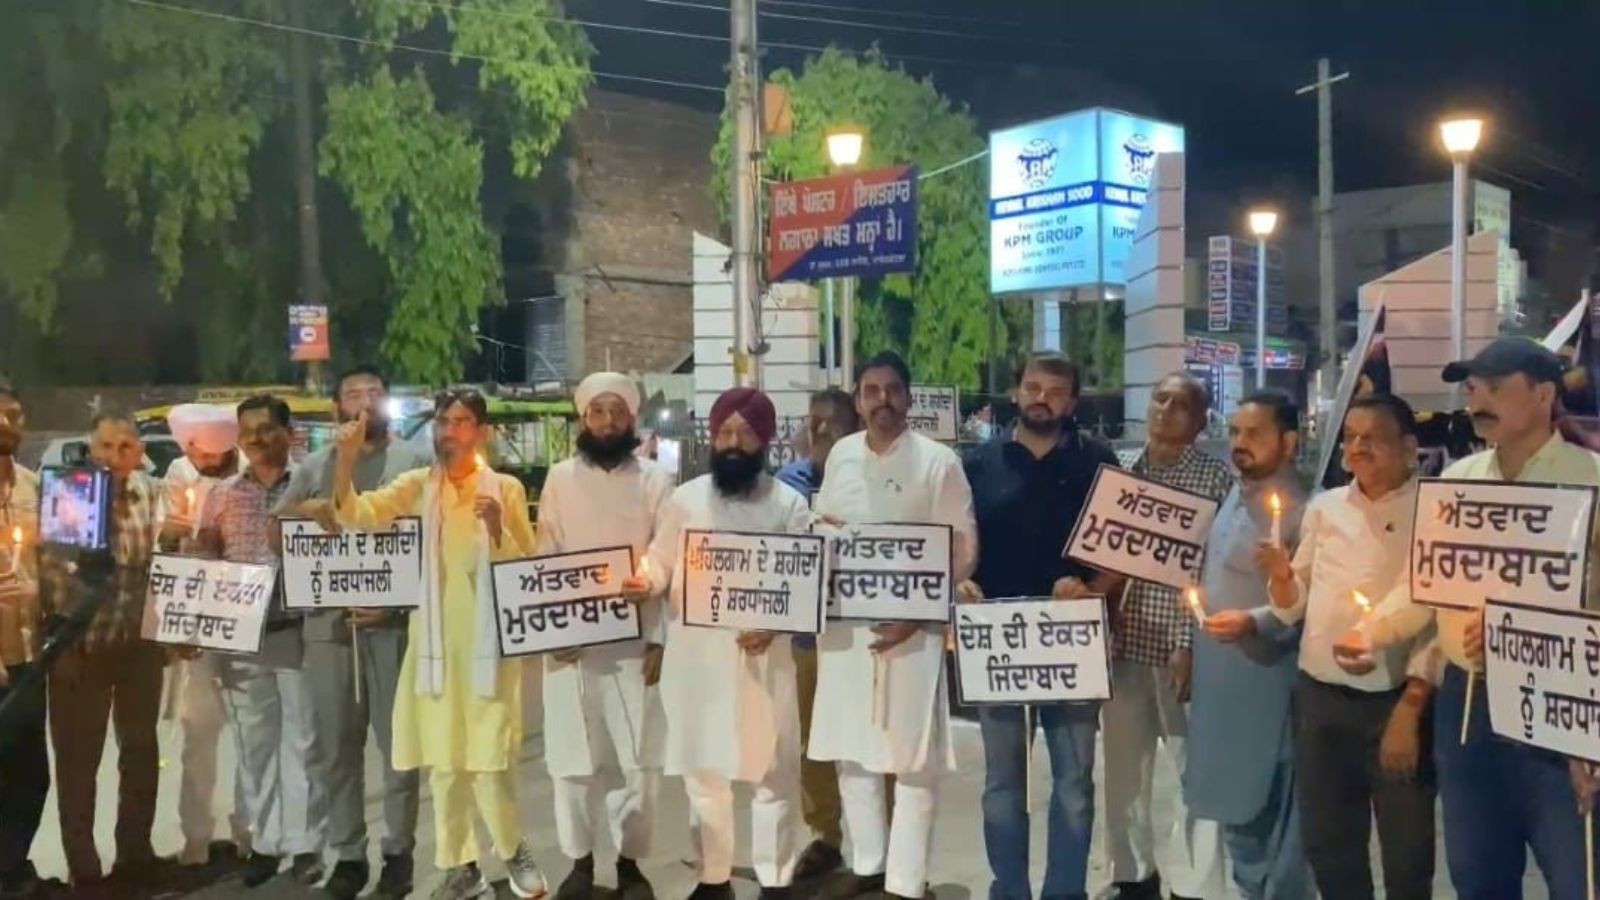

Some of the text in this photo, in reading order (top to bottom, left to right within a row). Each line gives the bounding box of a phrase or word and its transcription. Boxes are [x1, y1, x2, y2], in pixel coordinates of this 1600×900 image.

[1004, 226, 1084, 248] KPM GROUP
[1112, 226, 1136, 239] KPM
[1116, 485, 1198, 530] ਅੱਤਵਾਦ
[1437, 490, 1553, 534] ਅੱਤਵਾਦ
[285, 524, 350, 557] ਪਹਿਲਗਾਮ
[373, 523, 417, 556] ਸ਼ਹੀਦਾਂ
[689, 536, 818, 577] ਪਹਿਲਗਾਮ ਦੇ ਸ਼ਹੀਦਾਂ
[1081, 513, 1203, 571] ਮੁਰਦਾਬਾਦ
[185, 569, 206, 601] ਦੀ
[310, 559, 393, 605] ਨੂੰ ਸ਼ਰਧਾਂਜਲੀ
[519, 563, 610, 593] ਅੱਤਵਾਦ
[1417, 539, 1578, 592] ਮੁਰਦਾਬਾਦ
[503, 594, 631, 645] ਮੁਰਦਾਬਾਦ
[711, 575, 791, 622] ਨੂੰ ਸ਼ਰਧਾਂਜਲੀ
[162, 602, 238, 640] ਜਿੰਦਾਬਾਦ
[959, 611, 1100, 650] ਦੇਸ਼ ਦੀ ਏਕਤਾ
[1487, 611, 1600, 677] ਪਹਿਲਗਾਮ ਦੇ
[986, 654, 1078, 692] ਜਿੰਦਾਬਾਦ
[1519, 672, 1600, 739] ਨੂੰ ਸ਼ਰਧਾਂ
